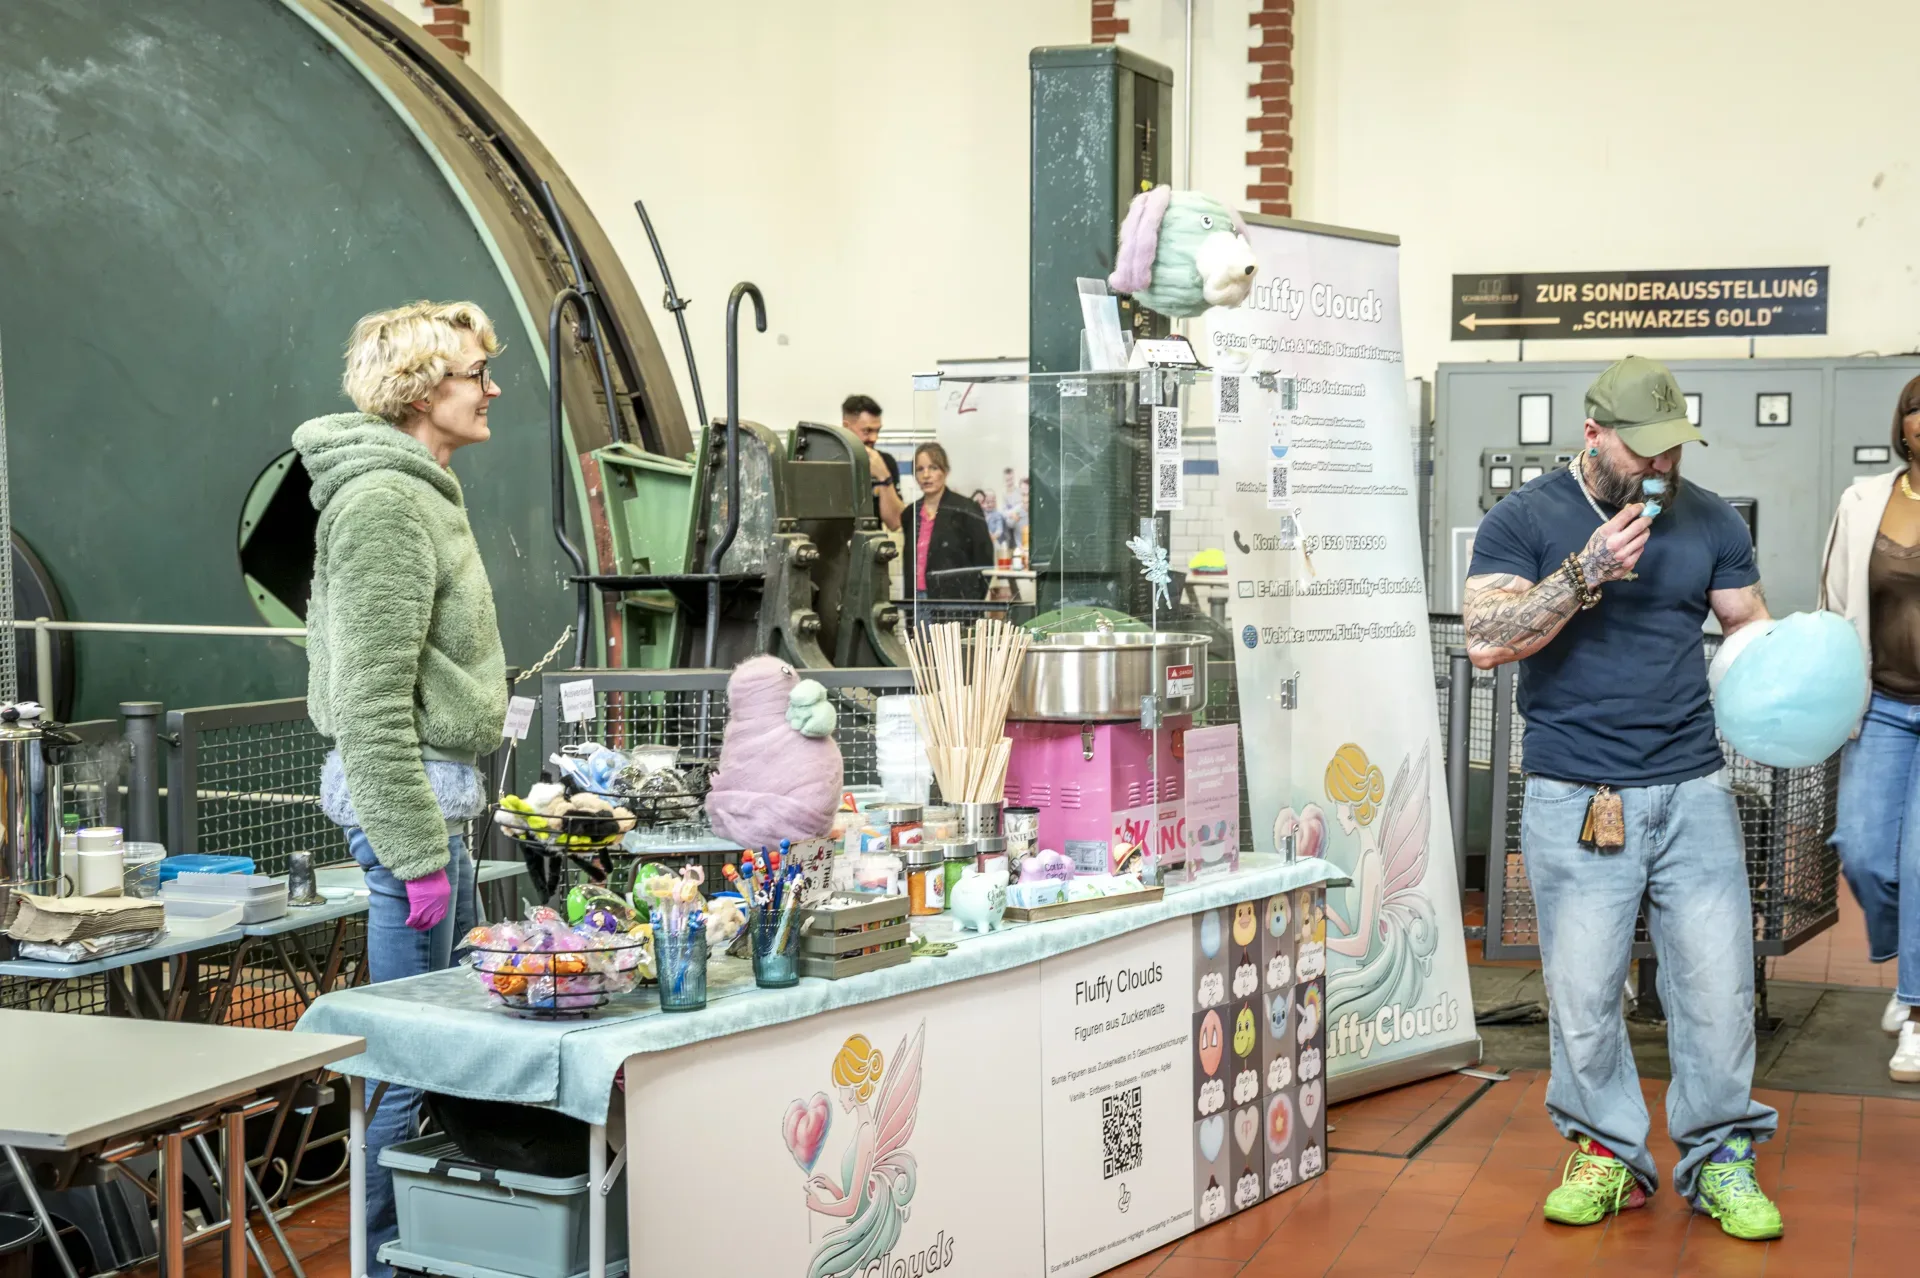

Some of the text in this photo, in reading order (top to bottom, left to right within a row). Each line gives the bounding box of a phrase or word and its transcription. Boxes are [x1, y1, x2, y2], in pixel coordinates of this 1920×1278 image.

[1250, 277, 1382, 322] luffy Clouds
[1536, 279, 1818, 303] ZUR SONDERAUSSTELLUNG
[1213, 331, 1402, 363] Cotton Candy Art & Mobile Dienstleistungen
[1322, 380, 1366, 397] Statement
[1320, 535, 1344, 550] 1520
[1262, 627, 1304, 644] Website:
[1044, 863, 1066, 872] Cotton
[1076, 961, 1163, 1006] Fluffy Clouds
[1075, 1003, 1165, 1042] Figuren aus Zuckerwatte
[1326, 992, 1458, 1060] uffyClouds
[1067, 1068, 1087, 1081] Figuren
[1088, 1065, 1097, 1074] aus
[1098, 1055, 1127, 1071] Zuckerwatte
[1132, 1050, 1137, 1059] 5
[1089, 1084, 1111, 1096] Erdbeere
